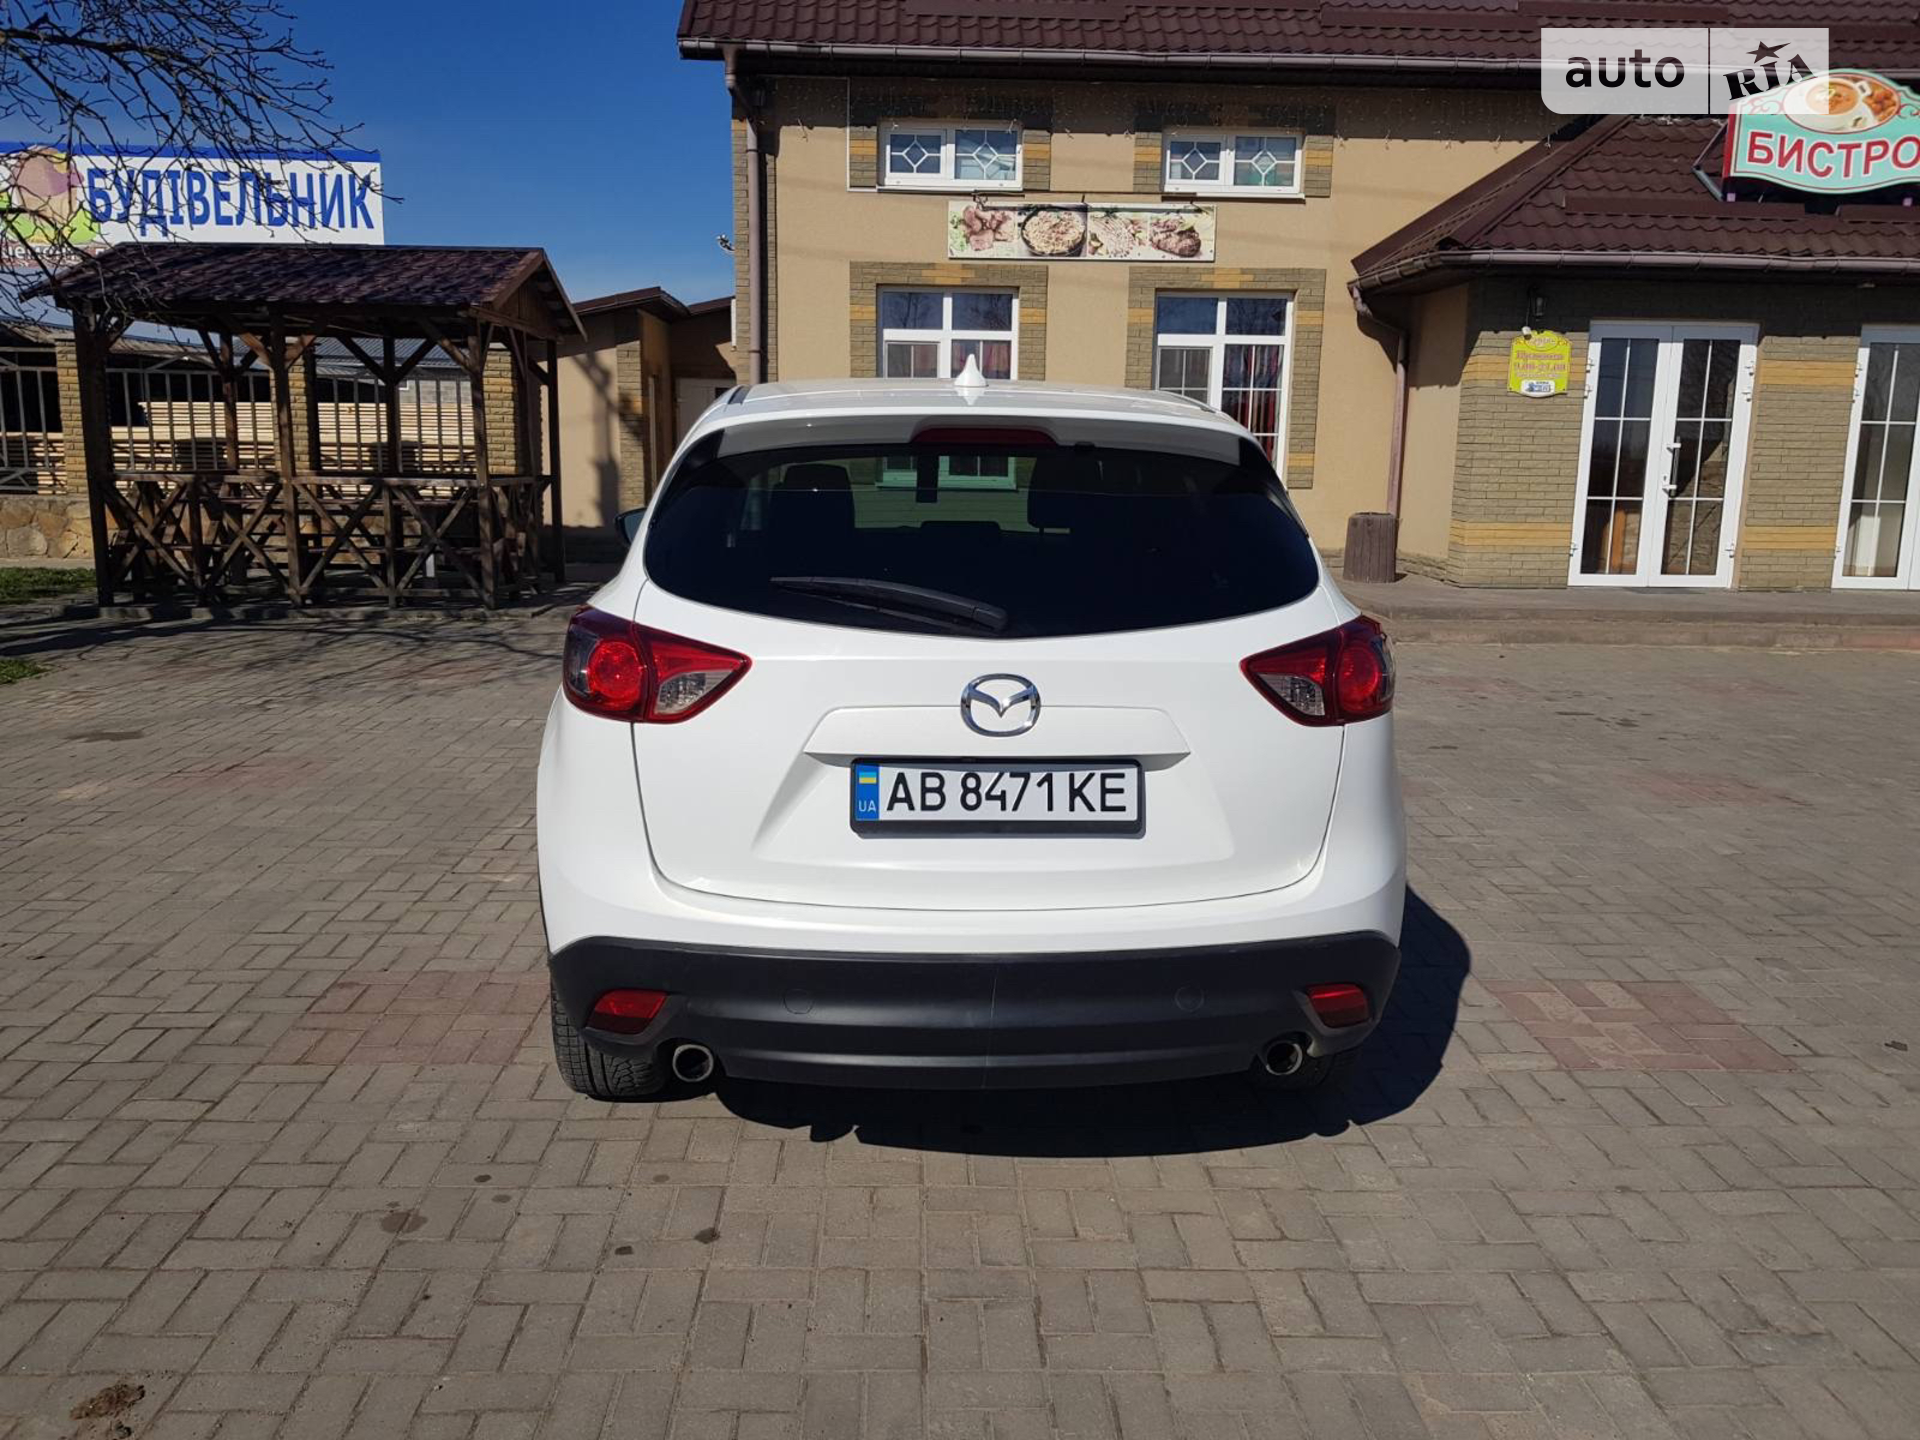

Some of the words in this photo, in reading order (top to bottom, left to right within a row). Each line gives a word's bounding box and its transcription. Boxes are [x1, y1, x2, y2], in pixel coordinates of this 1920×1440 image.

[1747, 131, 1920, 178] БИСТРО
[87, 168, 375, 237] БУДІВЕЛЬНИК
[859, 800, 876, 813] UA
[886, 772, 946, 812] AB
[960, 772, 1053, 812] 8471
[1068, 772, 1126, 812] KE
